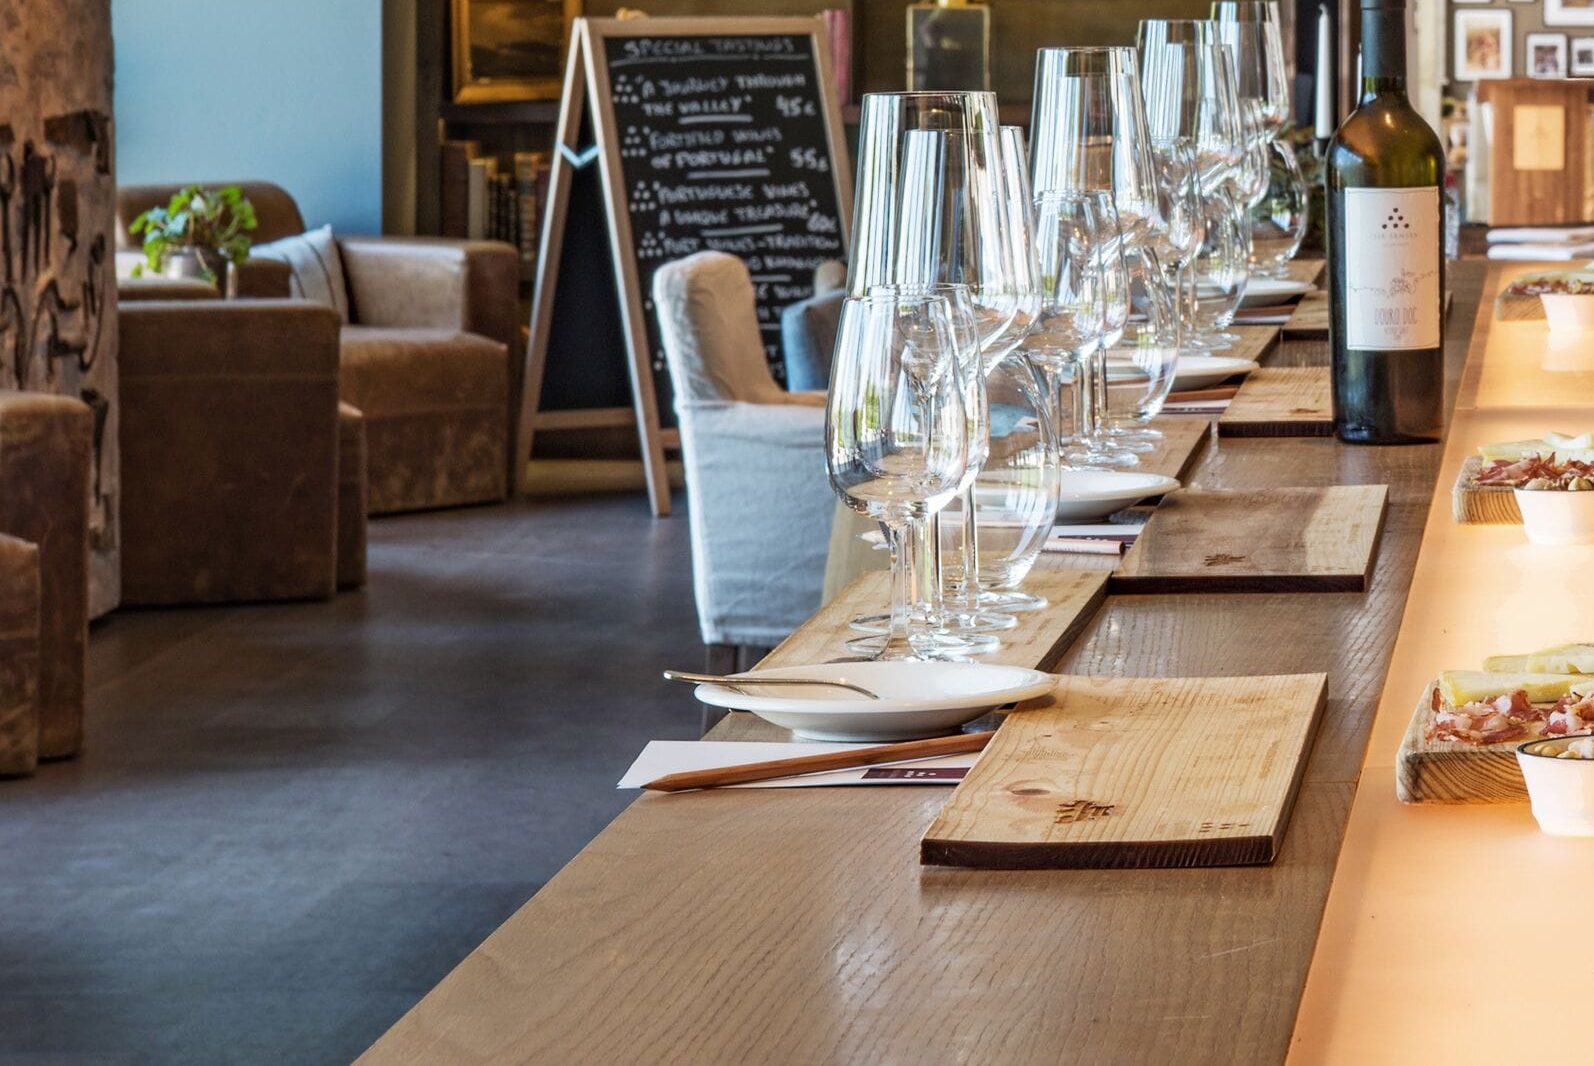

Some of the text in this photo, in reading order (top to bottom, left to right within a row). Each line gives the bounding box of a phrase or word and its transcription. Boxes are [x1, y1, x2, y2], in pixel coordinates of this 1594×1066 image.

[623, 38, 704, 57] SPECIAL
[642, 102, 673, 117] THE
[1403, 307, 1418, 325] DOC
